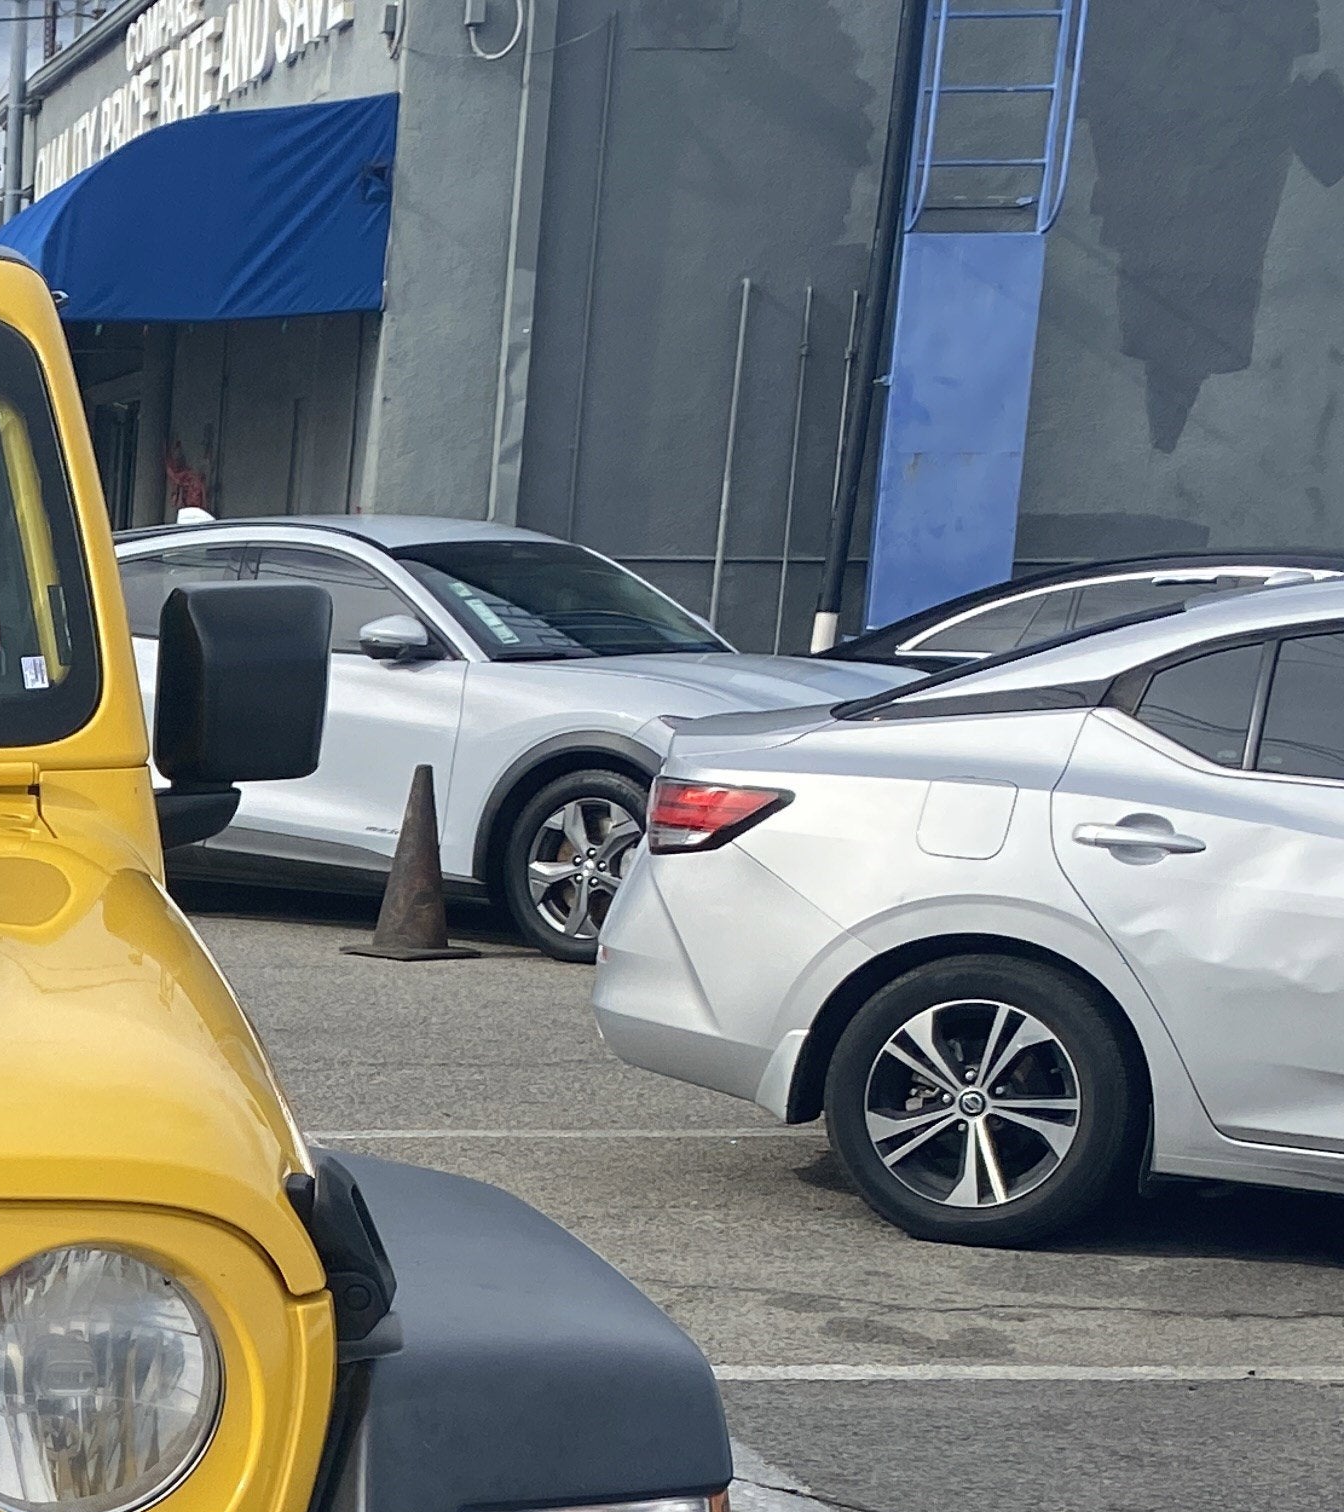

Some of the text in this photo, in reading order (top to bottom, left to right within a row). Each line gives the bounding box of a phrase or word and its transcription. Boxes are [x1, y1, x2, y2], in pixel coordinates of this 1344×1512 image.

[34, 0, 352, 203] QUALITY PRICE RATE AND SA
